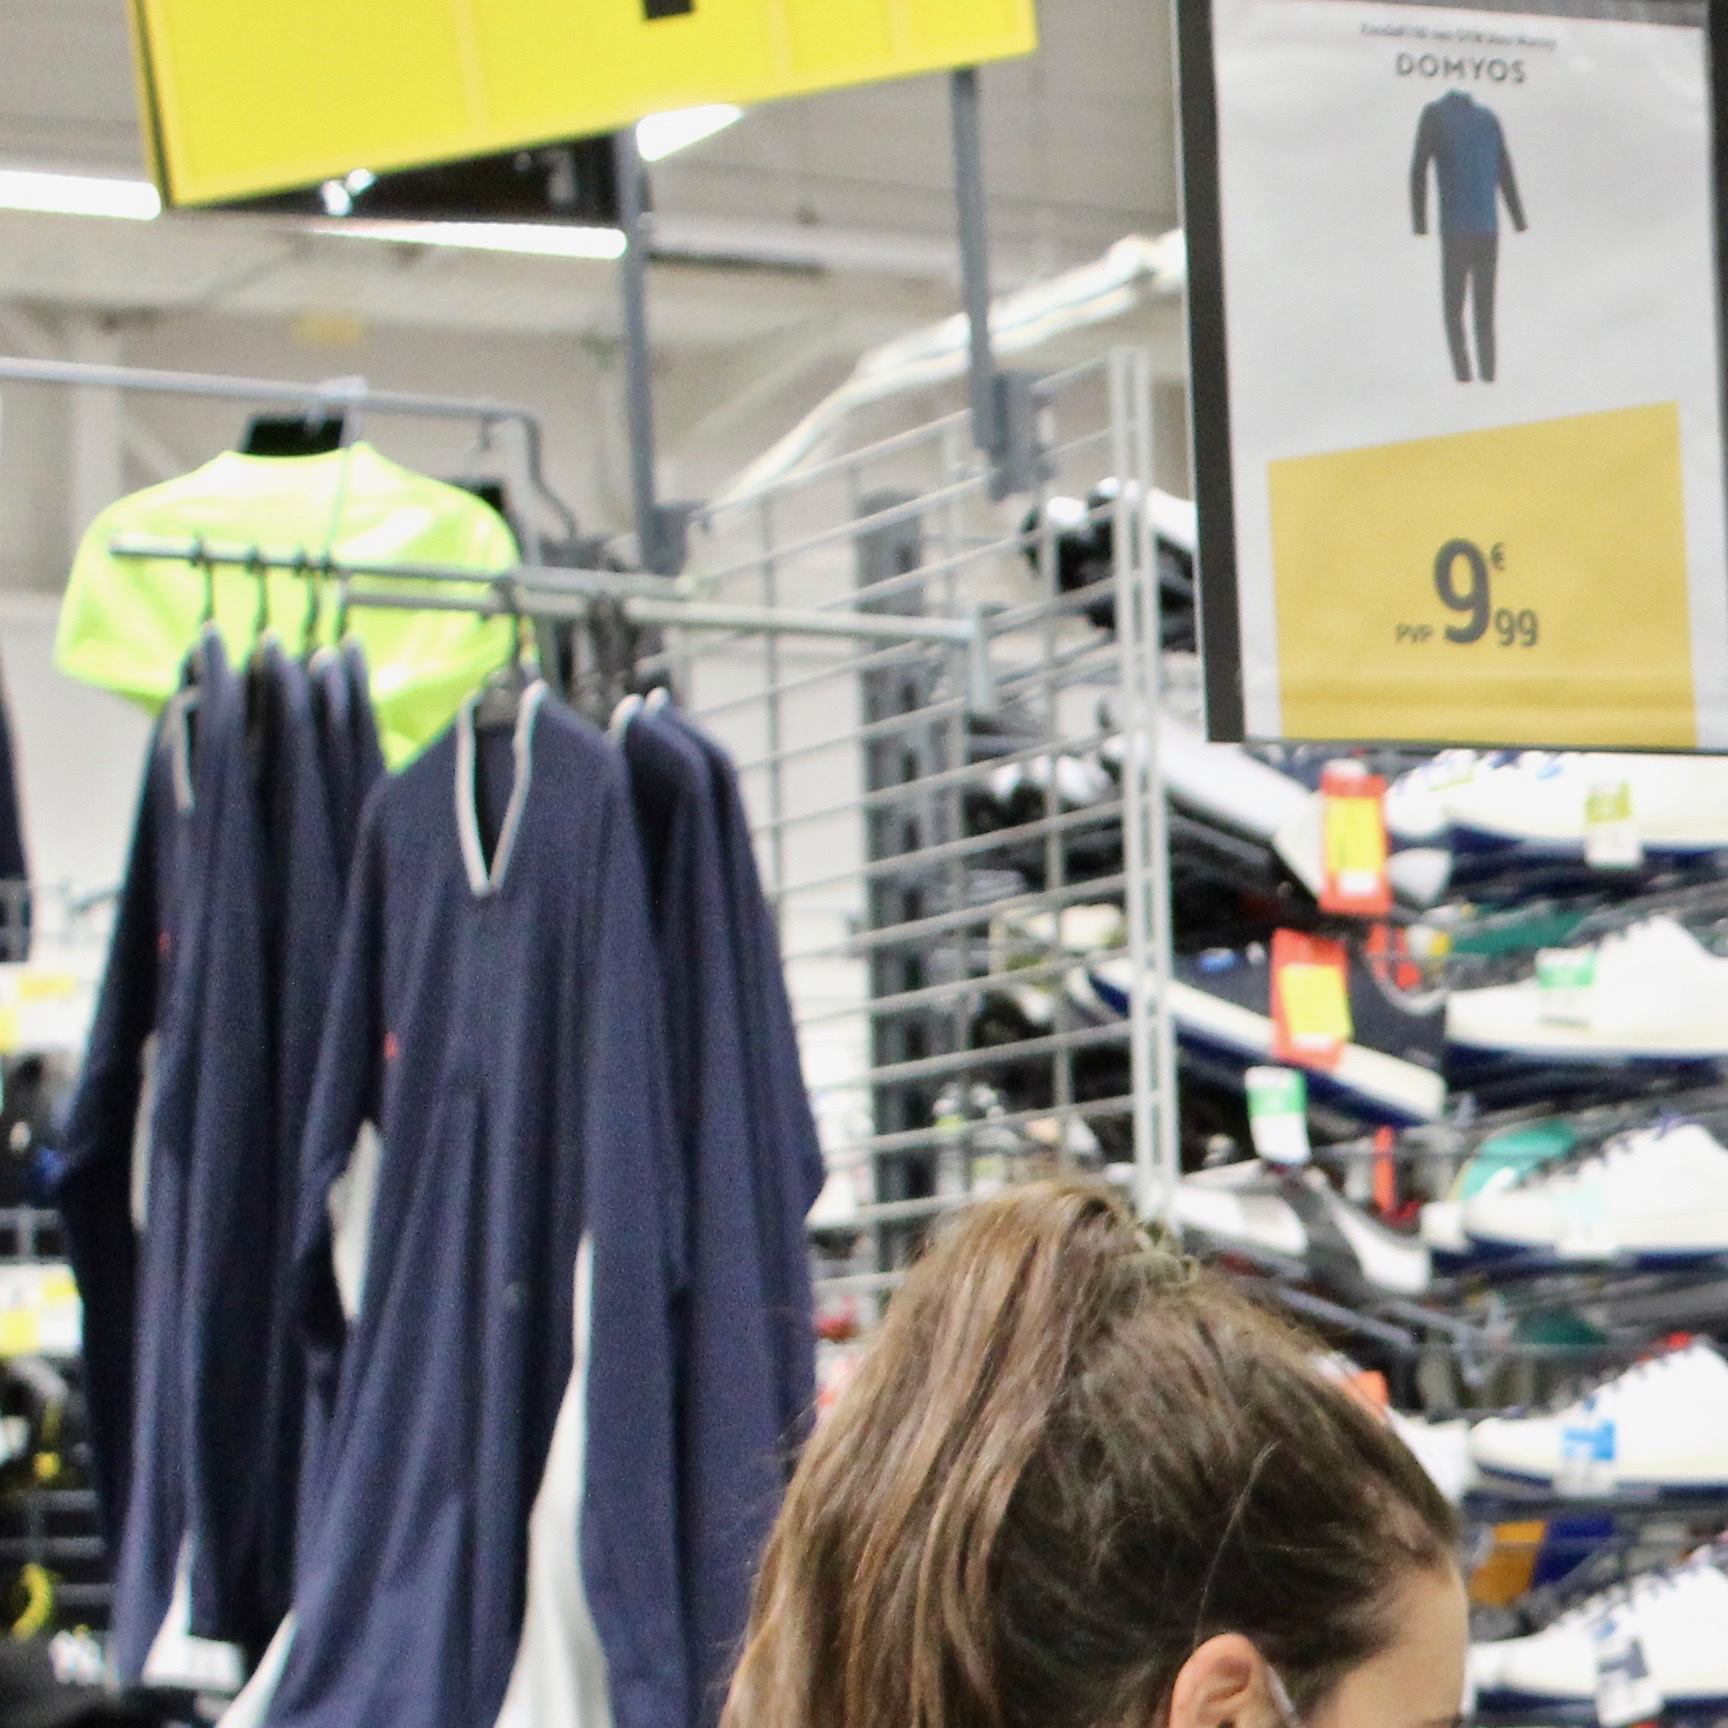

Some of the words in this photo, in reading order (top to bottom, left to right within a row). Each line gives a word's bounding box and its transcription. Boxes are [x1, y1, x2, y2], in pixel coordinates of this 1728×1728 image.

[1394, 50, 1527, 85] DOMYOS
[1431, 536, 1493, 645] 9
[1493, 607, 1540, 648] 99
